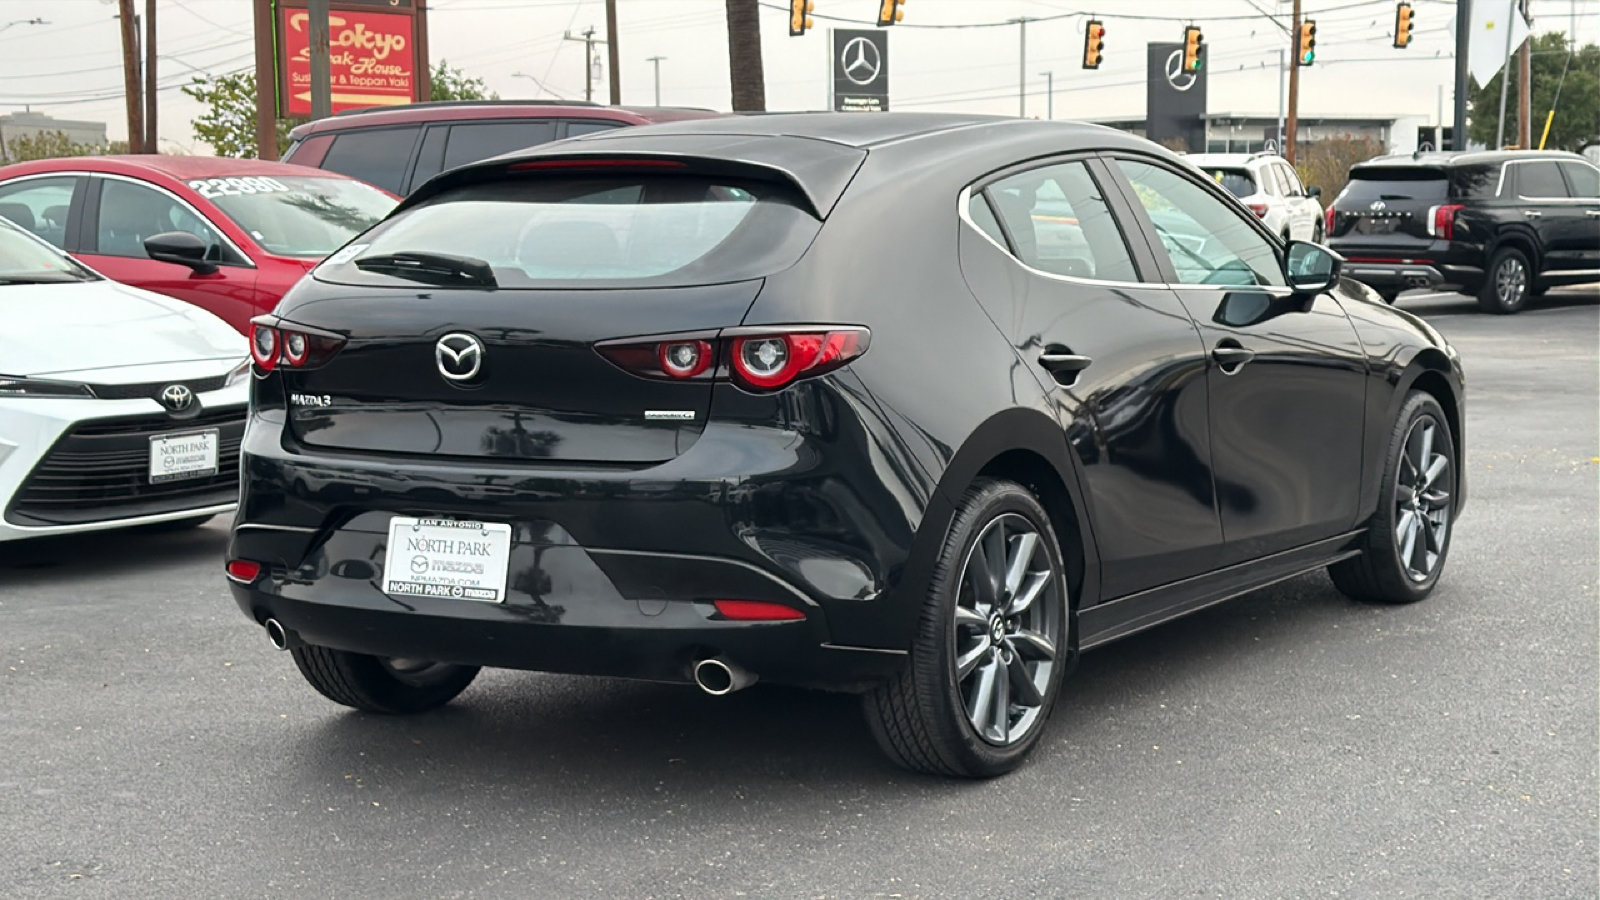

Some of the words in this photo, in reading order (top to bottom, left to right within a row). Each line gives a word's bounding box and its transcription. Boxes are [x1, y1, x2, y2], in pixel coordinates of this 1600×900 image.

[290, 13, 405, 59] Tokyo
[350, 58, 410, 75] House
[339, 74, 347, 84] &
[350, 75, 387, 86] Teppan
[388, 76, 409, 87] Yaki
[160, 443, 188, 455] NORTH
[190, 441, 209, 452] PARK
[419, 519, 437, 527] SAN
[440, 520, 482, 530] ANTONIO
[407, 537, 454, 554] NORTH
[458, 541, 492, 556] PARK
[432, 560, 483, 574] mazda
[391, 583, 423, 594] NORTH
[424, 585, 451, 597] PARK
[465, 588, 496, 600] mazda
